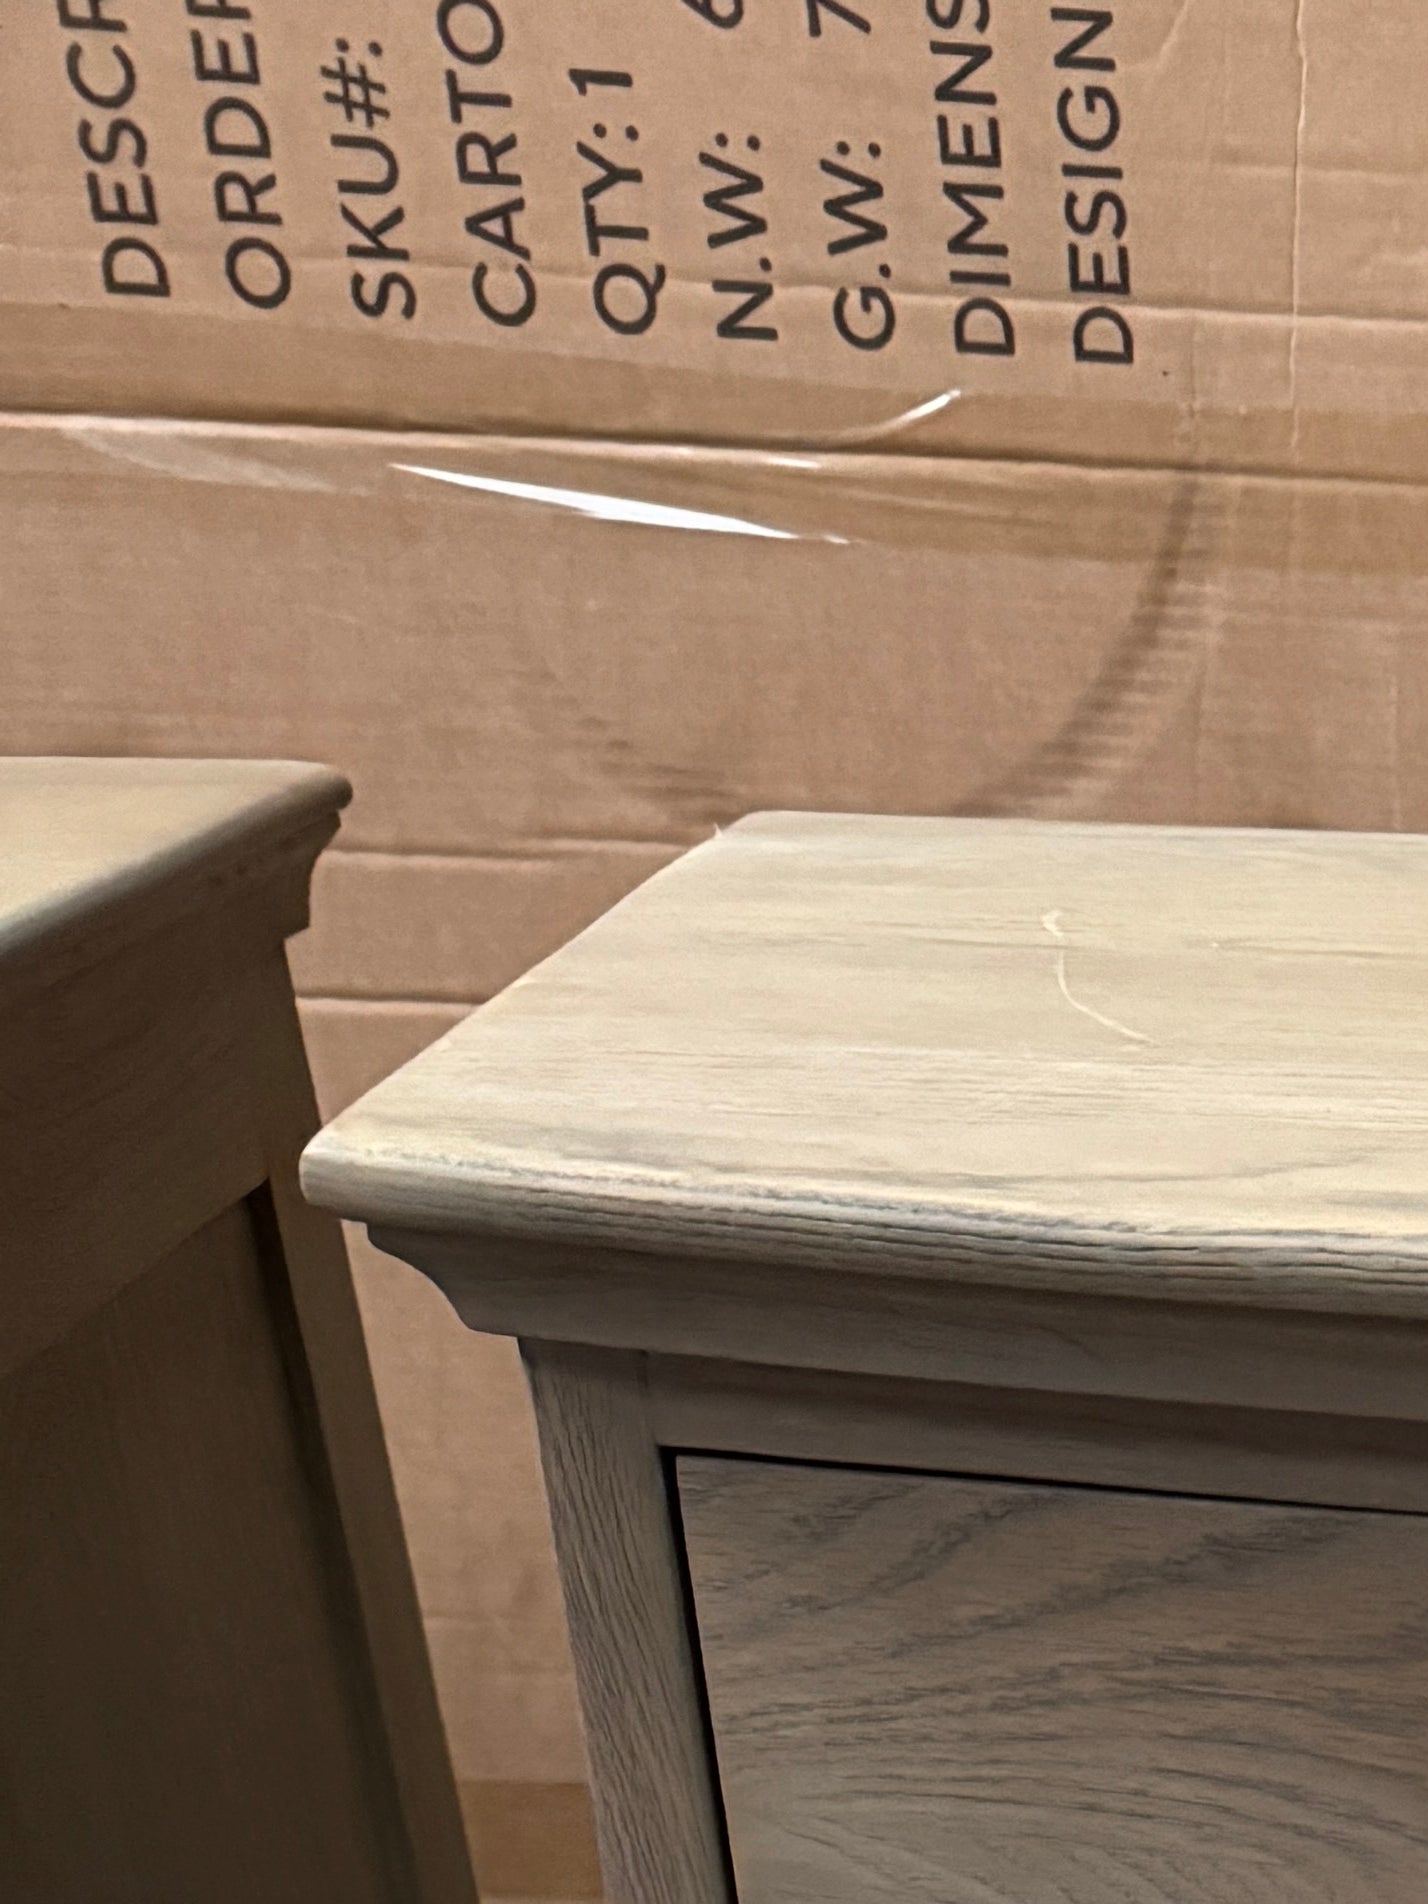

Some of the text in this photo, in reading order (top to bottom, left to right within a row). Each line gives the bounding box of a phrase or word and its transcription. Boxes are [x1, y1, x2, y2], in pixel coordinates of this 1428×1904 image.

[320, 37, 417, 320] SKU#:
[436, 0, 537, 327] CARTO
[698, 131, 778, 342] N.W:
[820, 140, 896, 351] G.W:
[925, 0, 1016, 357] DIMENS
[1050, 6, 1134, 365] DESIGN
